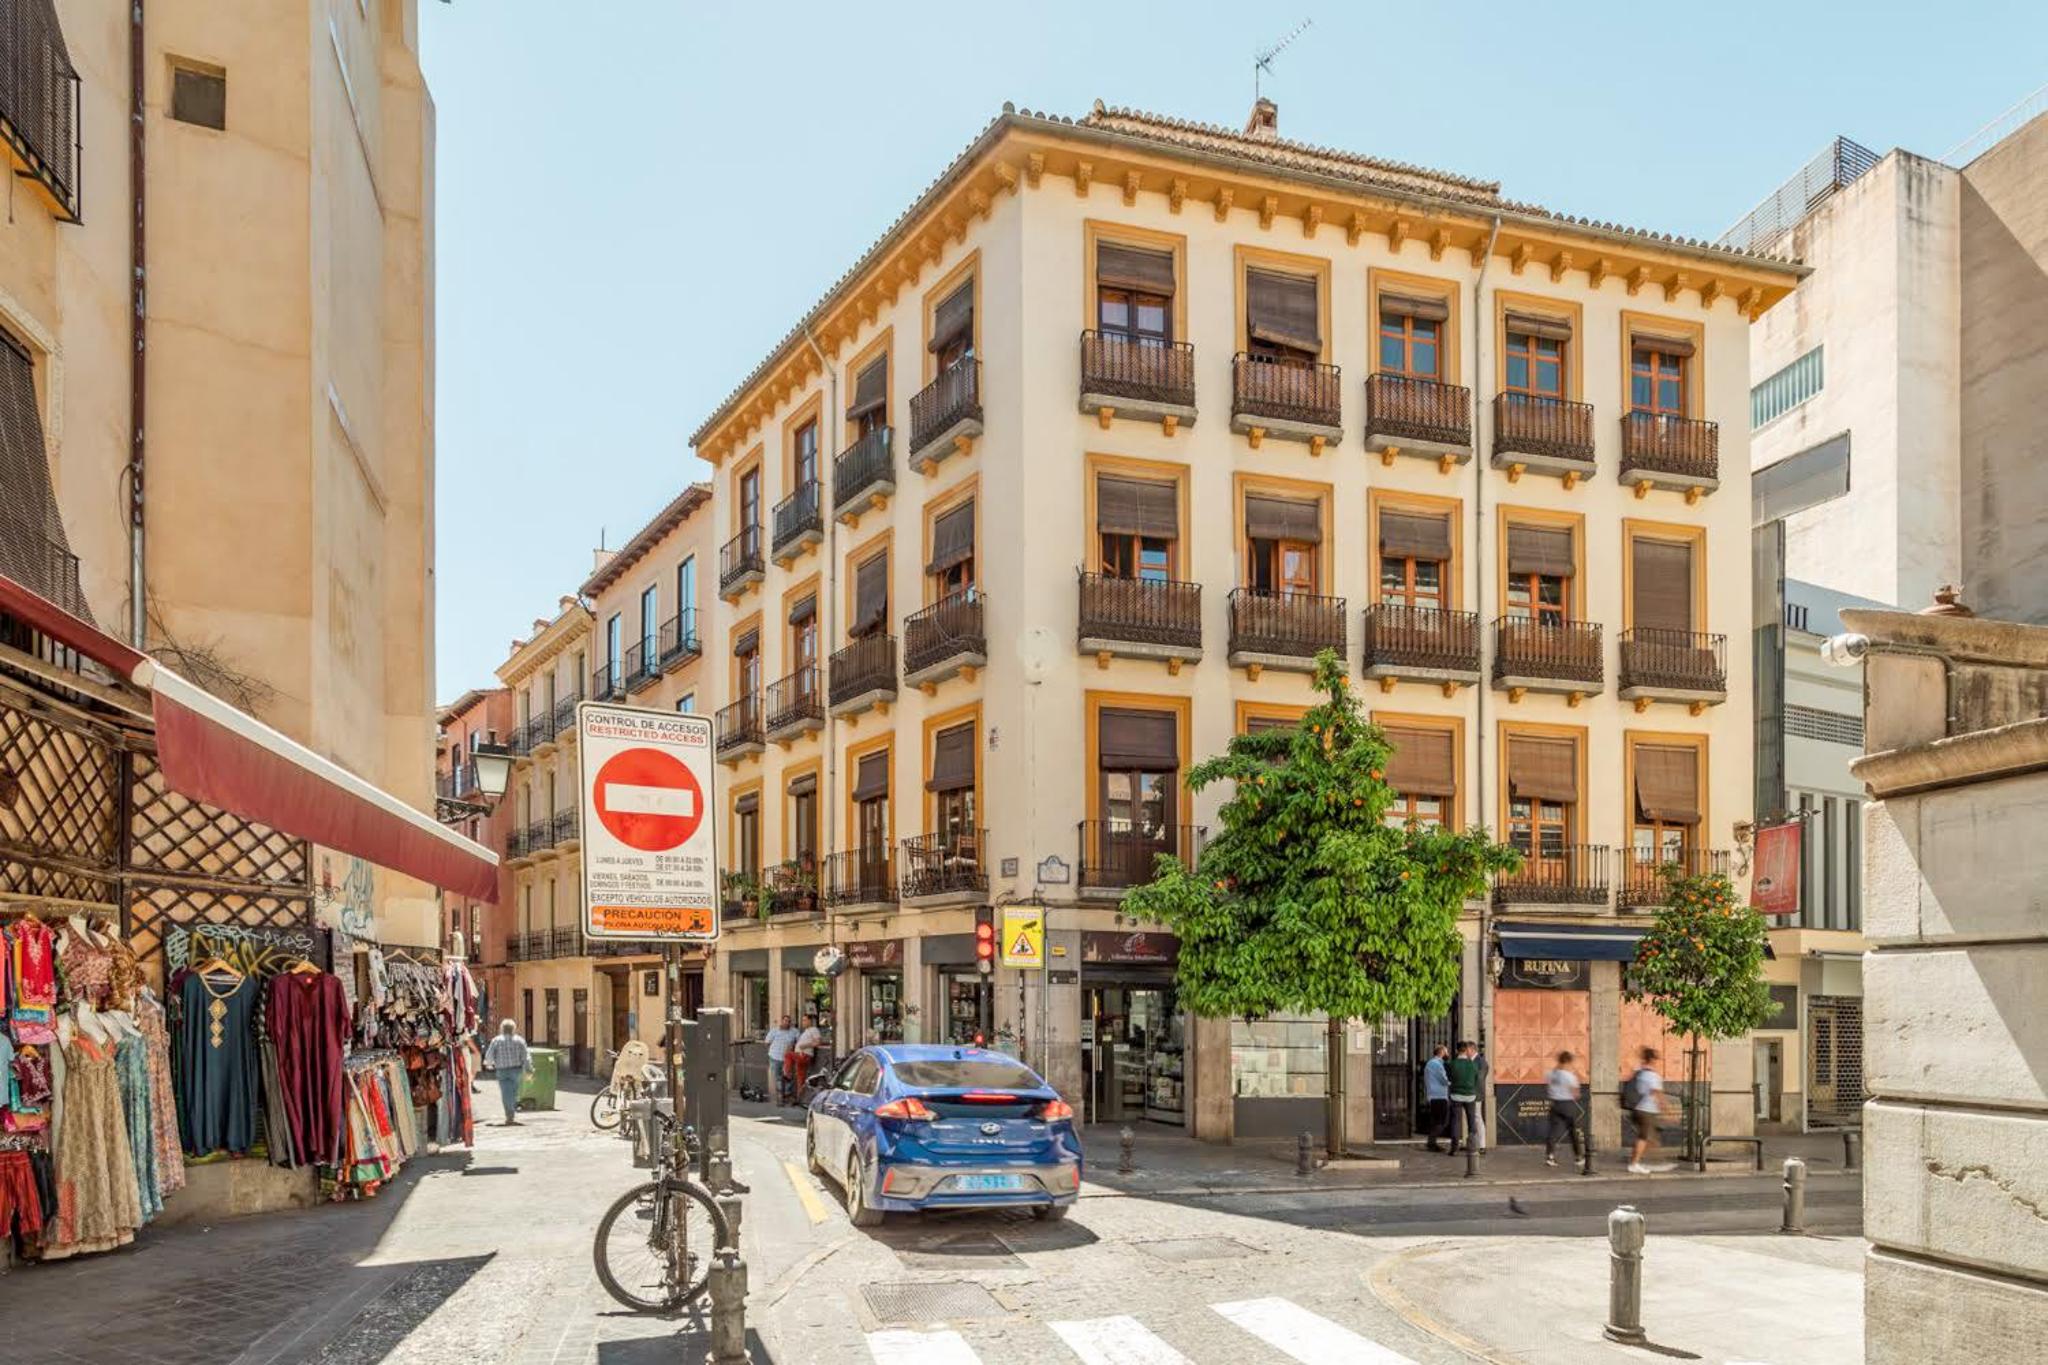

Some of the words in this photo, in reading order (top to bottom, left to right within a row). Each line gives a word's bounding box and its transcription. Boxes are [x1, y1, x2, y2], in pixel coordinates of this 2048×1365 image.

[586, 714, 639, 728] CONTROL
[641, 720, 655, 729] DE
[657, 722, 707, 735] ACCESOS
[589, 724, 659, 739] RESTRICTED
[660, 733, 704, 743] ACCESS
